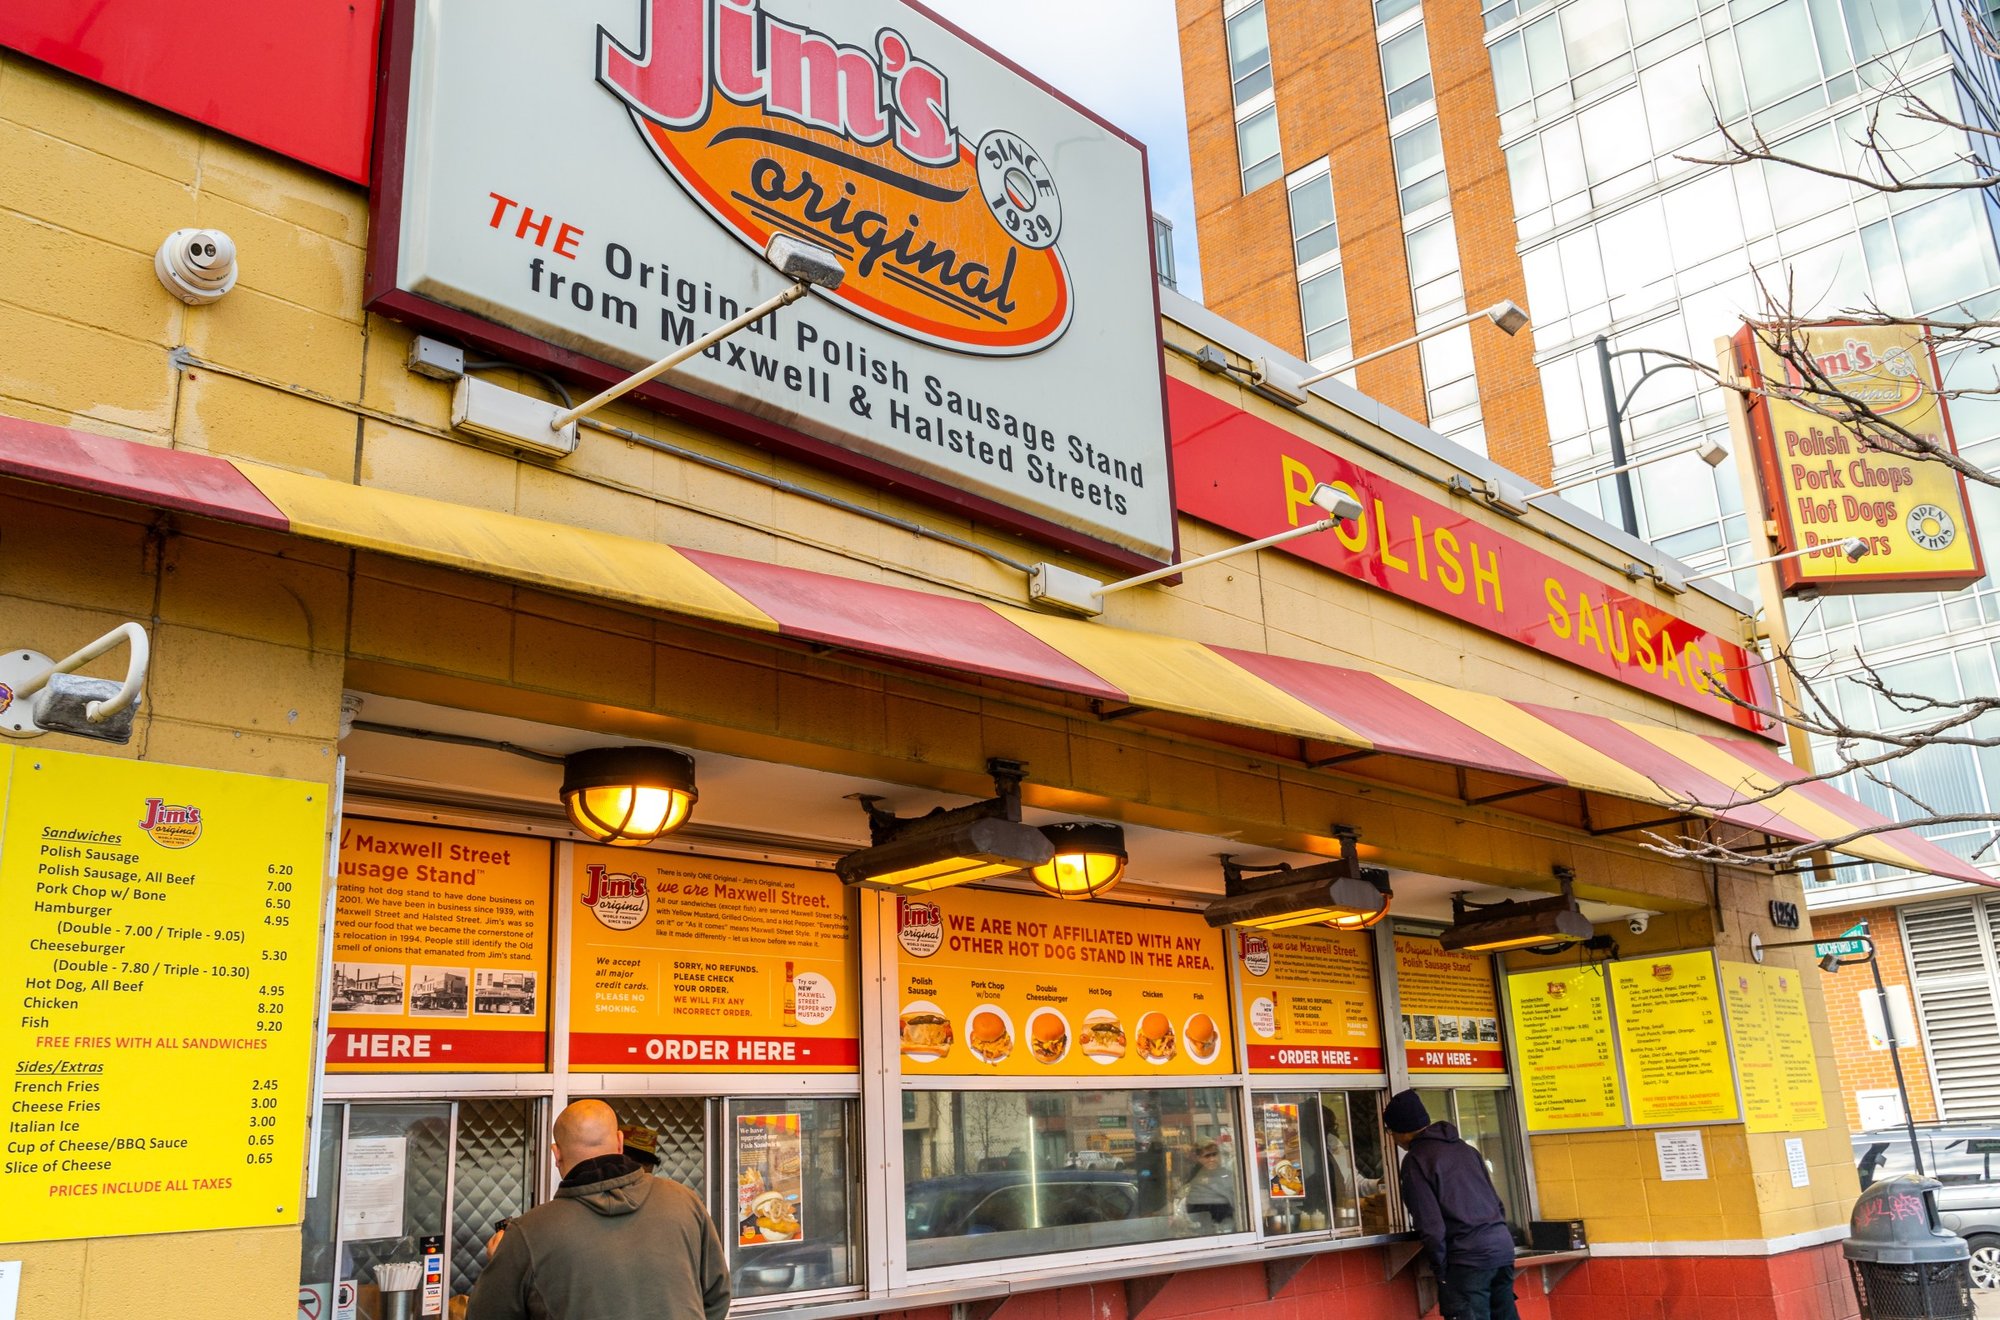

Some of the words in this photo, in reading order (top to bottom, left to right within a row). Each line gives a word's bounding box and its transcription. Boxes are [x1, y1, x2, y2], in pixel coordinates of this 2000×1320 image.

[595, 0, 961, 168] Jim's
[985, 139, 1054, 197] SINCE
[992, 193, 1052, 242] 1939
[749, 157, 1018, 319] original
[489, 192, 584, 260] THE
[605, 242, 777, 341] Original
[797, 320, 909, 394] Polish
[924, 375, 1056, 452] Sausage
[1068, 434, 1144, 488] Stand
[529, 258, 638, 330] from
[660, 307, 830, 404] Maxwell
[849, 385, 872, 420] &
[890, 399, 1013, 473] Halsted
[1028, 454, 1128, 516] Streets
[1784, 426, 1850, 457] Polish
[1791, 461, 1845, 491] Pork
[1849, 458, 1913, 492] Chops
[1798, 497, 1837, 525] Hot
[1842, 496, 1897, 527] Dogs
[1911, 506, 1947, 523] OPEN
[1912, 529, 1925, 545] 24
[1928, 528, 1954, 548] HRS
[1281, 454, 1504, 613] POLISH
[1544, 577, 1734, 705] SAUSAGE
[138, 797, 203, 830] Jim's
[42, 826, 122, 845] Sandwiches
[155, 824, 197, 836] original
[40, 844, 81, 859] Polish
[85, 849, 140, 864] Sausage
[356, 835, 443, 860] Maxwell
[450, 844, 510, 866] Street
[267, 864, 293, 876] 6.20
[581, 864, 648, 908] Jim's
[657, 882, 678, 894] we
[684, 883, 710, 896] are
[714, 884, 776, 904] Maxwell
[781, 890, 830, 908] Street.
[34, 901, 112, 917] Hamburger
[600, 900, 644, 914] original
[264, 916, 289, 927] 4.95
[336, 907, 372, 917] Maxwell
[374, 909, 400, 919] Street
[403, 911, 419, 919] and
[422, 913, 453, 922] Halsted
[455, 915, 482, 924] Street.
[485, 917, 505, 926] Jim's
[1773, 901, 1798, 929] 1250
[904, 928, 940, 942] original
[949, 914, 976, 932] WE
[981, 918, 1012, 936] ARE
[1017, 922, 1047, 938] NOT
[1053, 925, 1133, 946] AFFILIATED
[1137, 933, 1171, 949] WITH
[1175, 937, 1201, 952] ANY
[30, 939, 125, 955] Cheeseburger
[949, 936, 1003, 955] OTHER
[1008, 940, 1039, 958] HOT
[1044, 943, 1076, 961] DOG
[1080, 948, 1126, 964] STAND
[1130, 951, 1144, 966] IN
[1147, 952, 1173, 968] THE
[1177, 954, 1215, 971] AREA.
[1272, 942, 1284, 950] we
[1286, 942, 1298, 951] are
[1300, 942, 1331, 954] Maxwell
[1333, 944, 1358, 957] Street.
[1817, 941, 1851, 956] ROCHFORD
[1851, 941, 1859, 949] ST
[262, 950, 287, 961] 5.30
[596, 957, 610, 966] We
[612, 958, 641, 968] accept
[674, 962, 702, 971] SORRY,
[720, 964, 758, 974] REFUNDS.
[596, 969, 606, 977] all
[609, 970, 634, 980] major
[674, 973, 704, 982] PLEASE
[707, 974, 734, 982] CHECK
[911, 976, 933, 986] Polish
[26, 978, 51, 990] Hot
[56, 980, 87, 993] Dog,
[91, 980, 109, 991] All
[113, 981, 144, 992] Beef
[259, 986, 284, 996] 4.95
[596, 981, 619, 990] credit
[622, 982, 648, 990] cards.
[674, 984, 696, 993] YOUR
[699, 986, 729, 994] ORDER.
[908, 986, 937, 997] Sausage
[971, 981, 986, 990] Pork
[988, 981, 1004, 991] Chop
[1036, 985, 1058, 993] Double
[596, 992, 629, 1002] PLEASE
[632, 994, 644, 1002] NO
[976, 990, 1000, 999] w/bone
[1026, 993, 1068, 1004] Cheeseburger
[1100, 988, 1112, 998] Dog
[1142, 990, 1163, 999] Chicken
[24, 997, 79, 1010] Chicken
[674, 996, 686, 1004] WE
[690, 996, 709, 1004] WILL
[728, 998, 744, 1006] ANY
[258, 1003, 284, 1014] 8.20
[594, 1004, 638, 1014] SMOKING.
[674, 1007, 720, 1016] INCORRECT
[724, 1008, 752, 1017] ORDER.
[21, 1017, 49, 1028] Fish
[256, 1021, 282, 1032] 9.20
[36, 1037, 70, 1048] FREE
[74, 1037, 111, 1048] FRIES
[115, 1038, 152, 1049] WITH
[155, 1038, 179, 1049] ALL
[182, 1038, 267, 1050] SANDWICHES
[347, 1035, 431, 1057] HERE
[646, 1039, 730, 1060] ORDER
[737, 1041, 796, 1061] HERE
[1278, 1050, 1319, 1065] ORDER
[1322, 1051, 1351, 1065] HERE
[1426, 1053, 1446, 1065] PAY
[1449, 1053, 1472, 1065] HERE
[15, 1061, 104, 1075] Sides/Extras
[14, 1081, 62, 1093] French
[67, 1081, 100, 1092] Fries
[252, 1080, 278, 1091] 2.45
[12, 1101, 63, 1113] Cheese
[68, 1101, 101, 1112] Fries
[251, 1098, 277, 1109] 3.00
